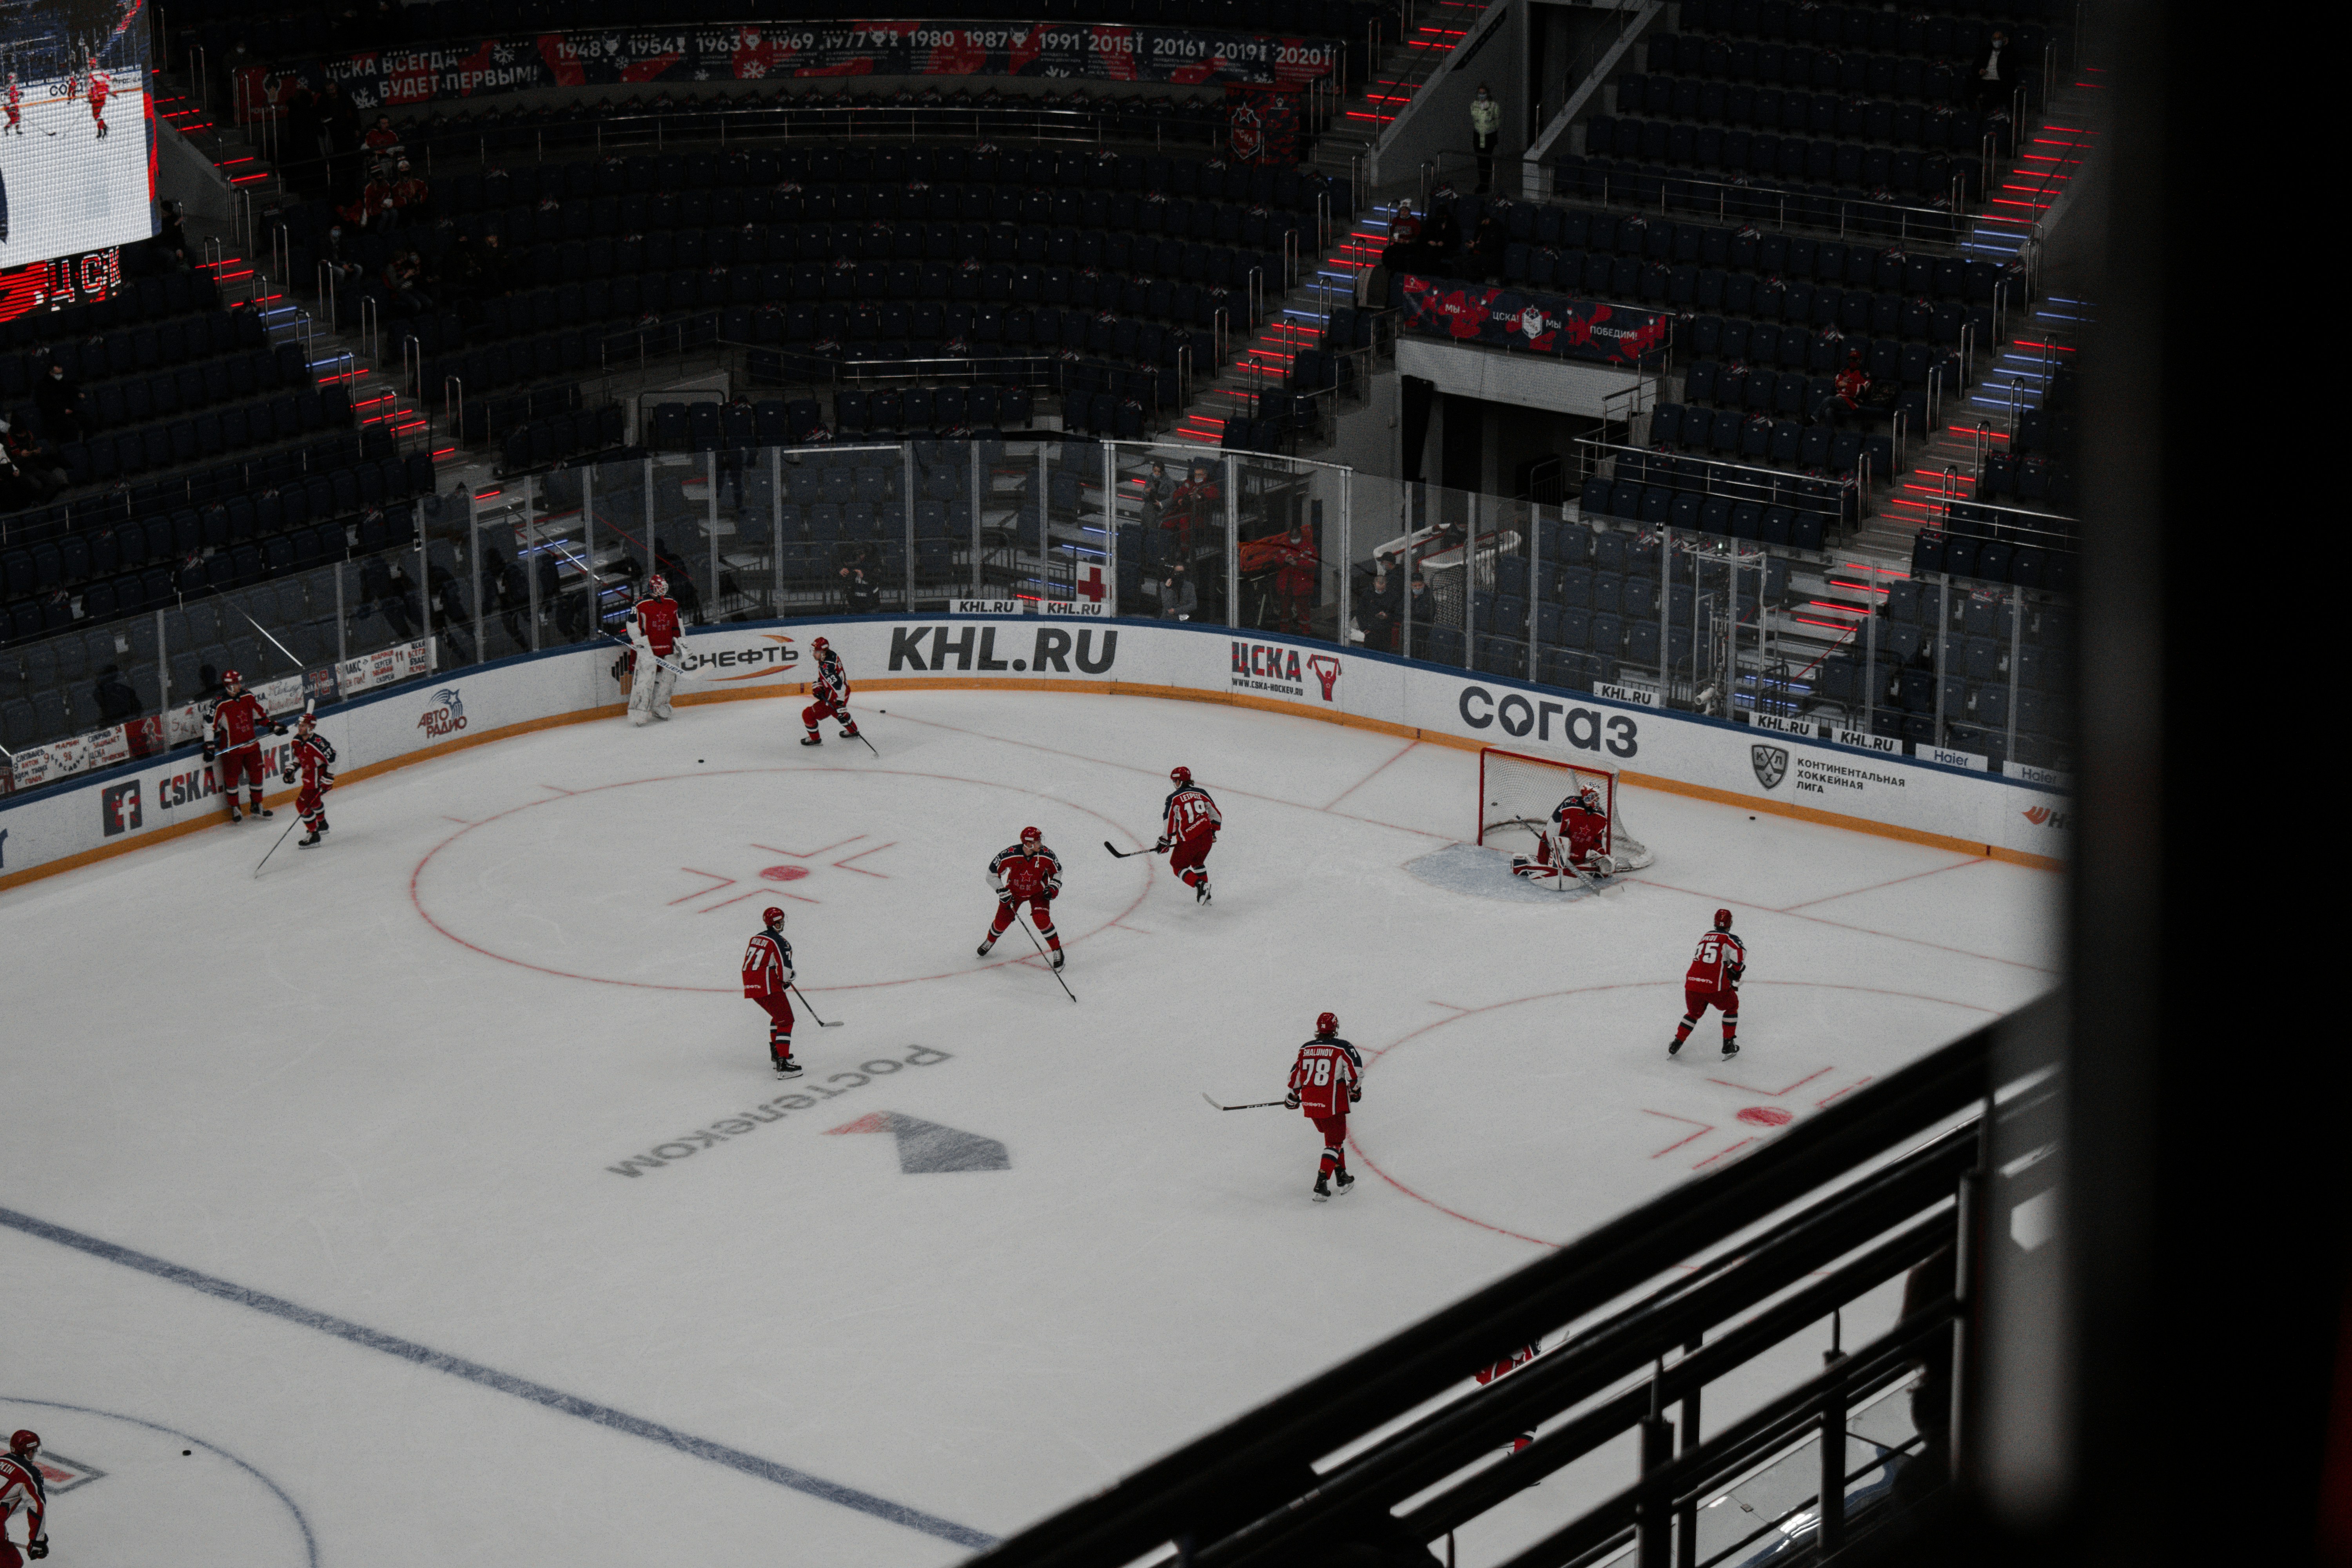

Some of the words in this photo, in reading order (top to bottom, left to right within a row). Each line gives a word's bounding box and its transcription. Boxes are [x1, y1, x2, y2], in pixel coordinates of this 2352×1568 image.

[628, 37, 675, 55] 1954
[695, 35, 742, 53] 1963
[769, 33, 814, 50] 1969
[824, 31, 867, 49] 1977
[907, 30, 955, 47] 1980
[964, 31, 1008, 48] 1987
[1039, 33, 1080, 50] 1991
[1088, 36, 1133, 53] 2015
[1152, 38, 1196, 56] 2016
[556, 41, 601, 59] 1948
[1215, 42, 1256, 60] 2019
[1275, 47, 1321, 65] 2020
[382, 51, 458, 74] ВСЕГДА
[379, 75, 440, 98] БУДЕТ
[445, 65, 538, 91] ПЕРВЫМ!
[1445, 303, 1460, 314] МЫ
[1492, 311, 1520, 323] ЦСКА!
[1546, 319, 1562, 330] МЫ
[1590, 325, 1638, 341] ПОБЕДИМ!
[959, 601, 1014, 613] KHL.RU
[1047, 603, 1102, 615] KHL.RU
[681, 646, 799, 671] СНЕФТЬ
[888, 626, 1118, 674] KHL.RU
[1231, 642, 1302, 682] ЦСКА
[1232, 677, 1303, 696] WWW.CSKA-HOCKEY.RU
[1601, 684, 1652, 706] KHL.RU
[417, 708, 449, 729] АВТО
[426, 716, 467, 739] РАДИО
[1757, 715, 1809, 735] KHL.RU
[1840, 731, 1894, 752] KHL.RU
[1934, 750, 1968, 767] Haier
[1797, 758, 1905, 787] КОНТИНЕНТАЛЬНАЯ
[1797, 769, 1864, 790] ХОККЕЙНАЯ
[2022, 767, 2058, 784] Haier
[1796, 780, 1824, 794] ЛИГА
[742, 946, 766, 971] 71
[1303, 1048, 1334, 1057] SHALUNOV
[1301, 1058, 1332, 1087] 78
